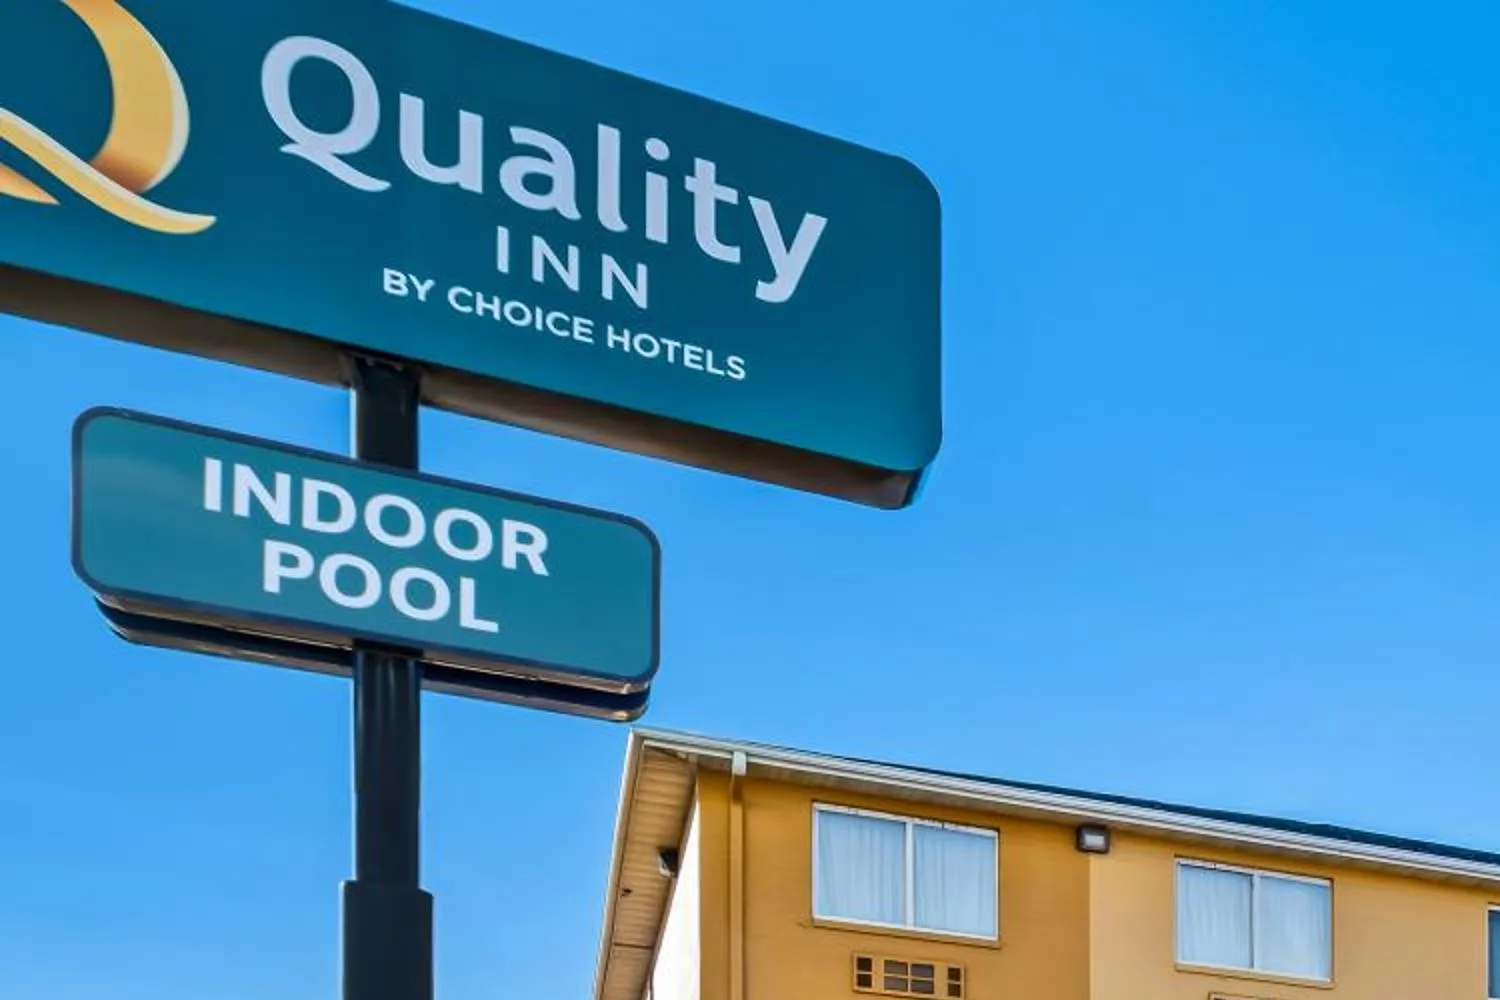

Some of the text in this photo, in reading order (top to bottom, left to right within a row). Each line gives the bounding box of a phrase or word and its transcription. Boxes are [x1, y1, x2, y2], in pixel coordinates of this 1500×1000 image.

[261, 35, 828, 303] Quality
[382, 267, 747, 381] BY CHOICE HOTELS
[496, 226, 649, 309] INN
[203, 457, 550, 577] INDOOR
[262, 539, 499, 633] POOL
